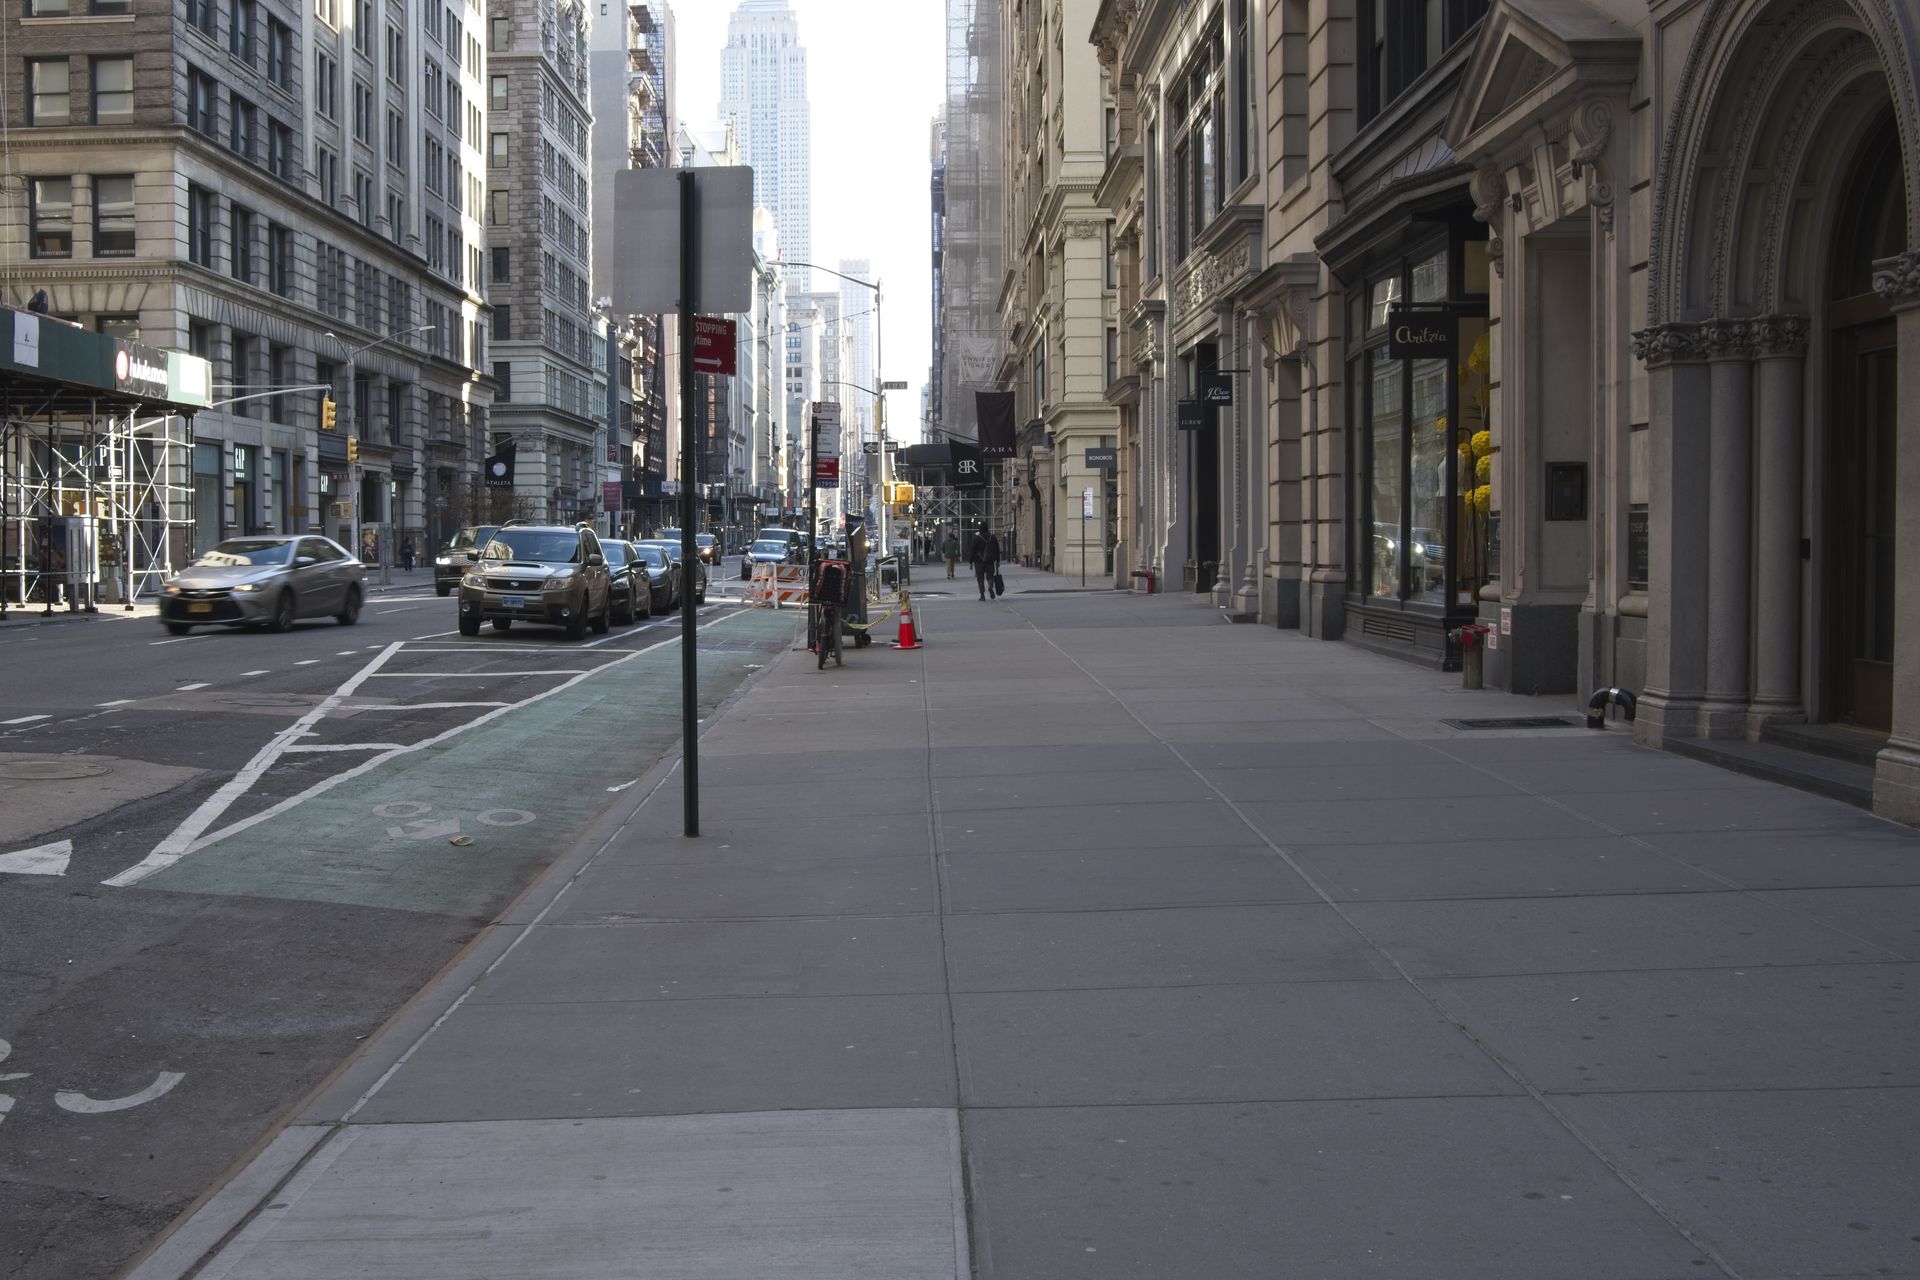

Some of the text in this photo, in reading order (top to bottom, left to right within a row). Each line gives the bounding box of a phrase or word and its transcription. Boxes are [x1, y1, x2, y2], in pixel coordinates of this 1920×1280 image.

[695, 321, 727, 335] STOPPING
[1395, 325, 1448, 344] Aritzia
[129, 355, 168, 385] lululemon
[235, 448, 245, 469] GAP
[320, 475, 329, 492] GAP
